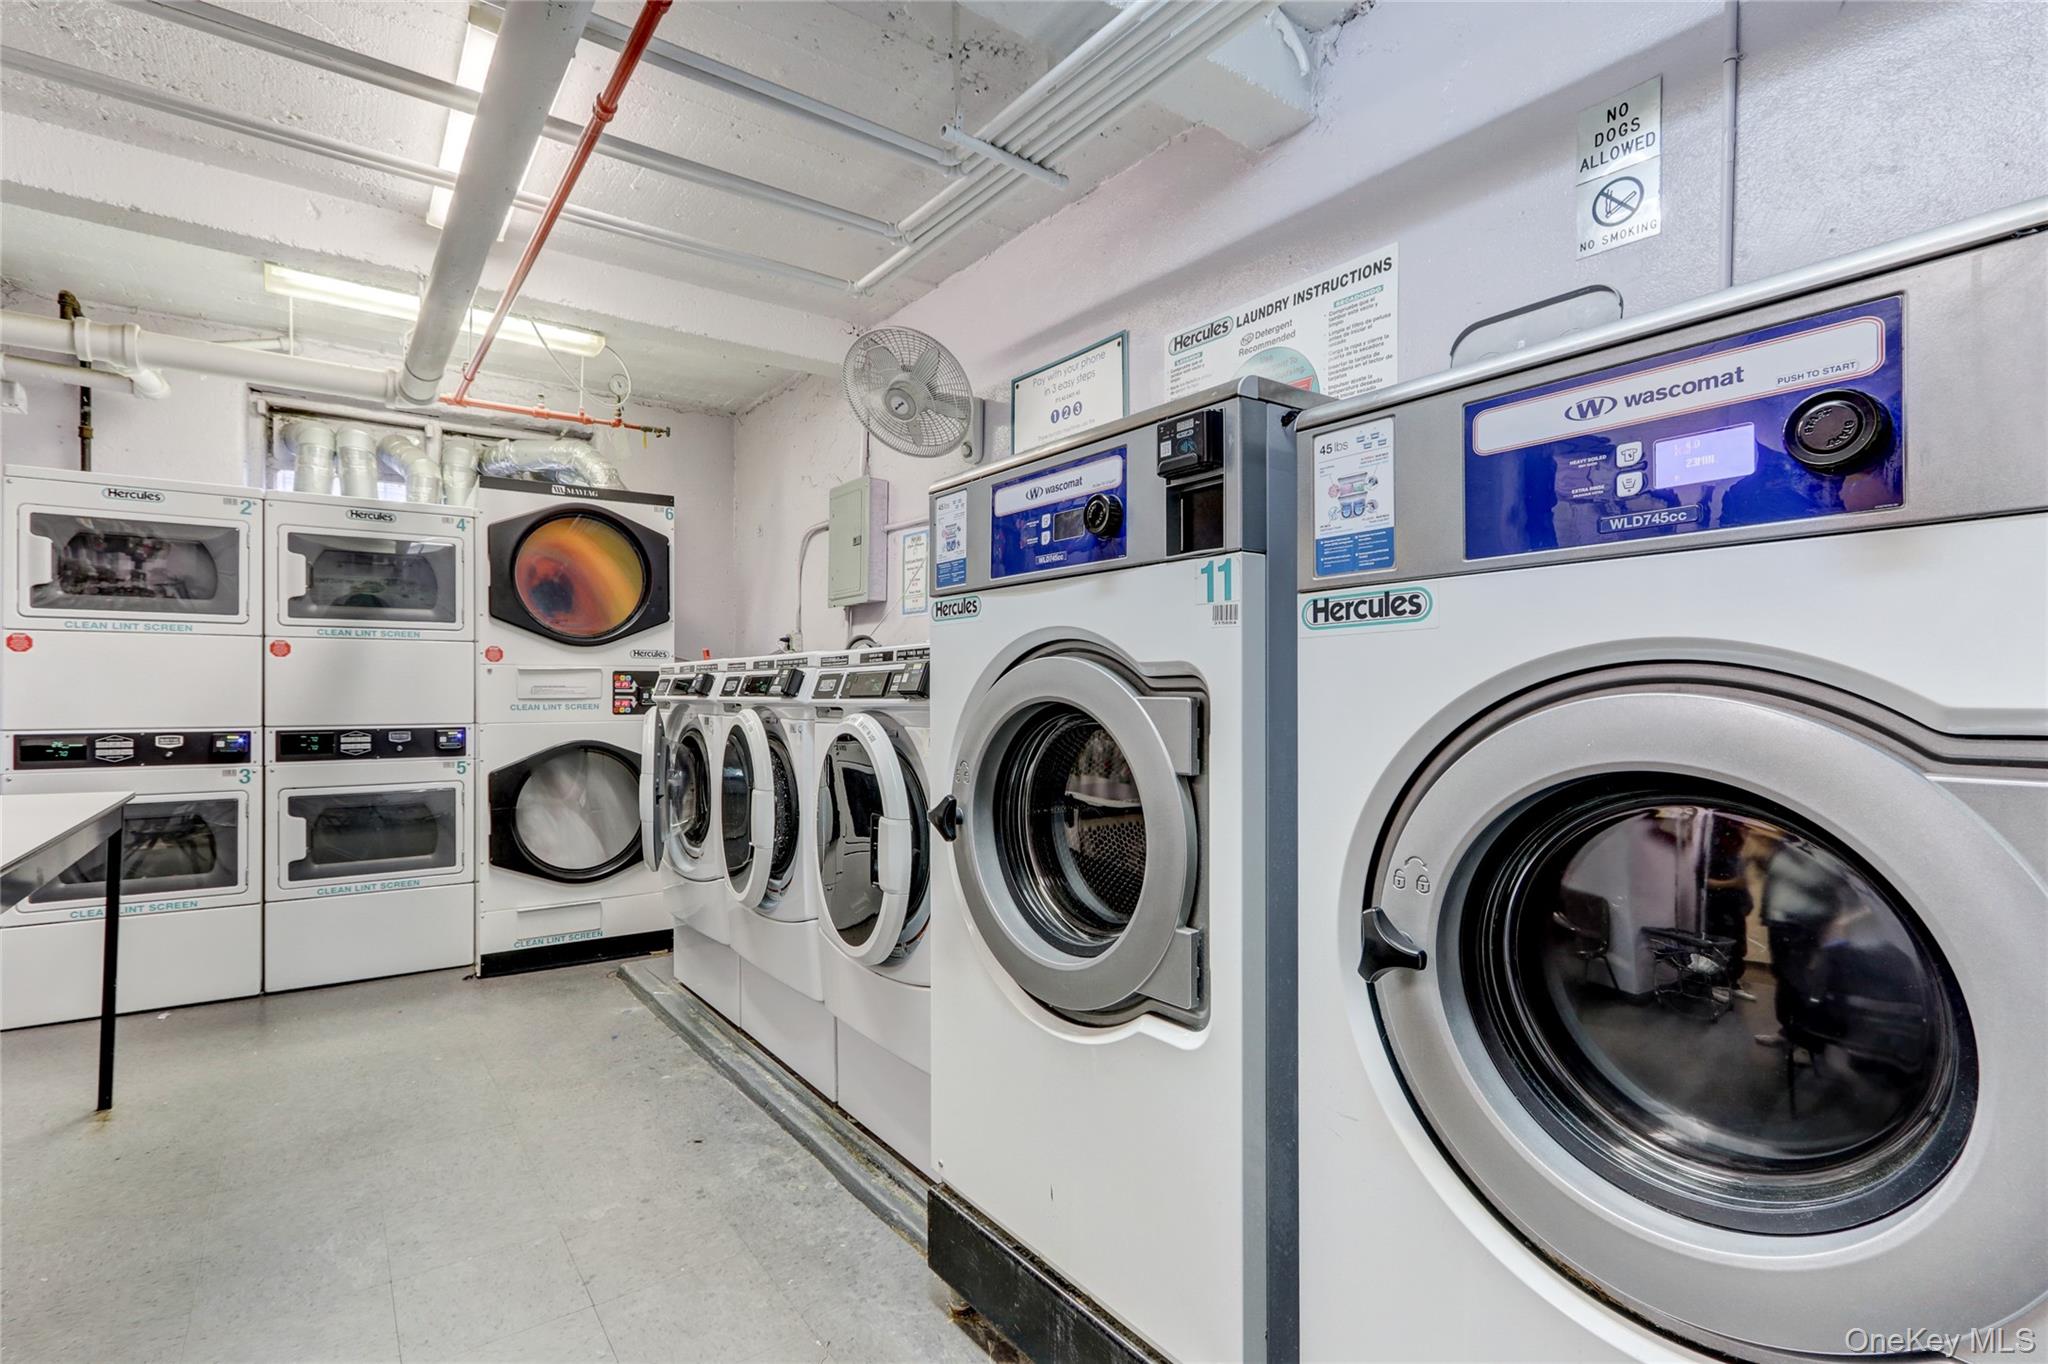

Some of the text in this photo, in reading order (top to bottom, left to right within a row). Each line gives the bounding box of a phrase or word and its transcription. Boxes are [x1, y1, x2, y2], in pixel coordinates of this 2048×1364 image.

[1607, 102, 1628, 123] NO
[1594, 117, 1641, 147] DOGS
[1579, 131, 1656, 173] ALLOWED
[1579, 219, 1657, 252] NO SMOKING
[1173, 257, 1392, 352] Hercules LAUNDRY INSTRUCTIONS
[1255, 320, 1293, 340] Detergent
[1239, 330, 1296, 357] Recommended
[1081, 352, 1105, 370] phone
[1777, 361, 1856, 385] PUSH TO START
[1624, 366, 1745, 408] wascomat
[1320, 441, 1348, 455] 45 lbs
[1569, 458, 1588, 466] HEAVY
[107, 488, 161, 501] Hercules
[1045, 476, 1083, 495] wascomat
[240, 500, 252, 515] 2
[350, 510, 393, 522] Hercules
[664, 507, 674, 520] 6
[456, 518, 466, 532] 4
[1610, 512, 1687, 530] WLD745cc
[1200, 557, 1232, 603] 11
[935, 598, 978, 617] Hercules
[1312, 591, 1422, 623] Hercules
[64, 620, 193, 632] CLEAN LINT SCREEN
[317, 628, 351, 637] CLEAN
[380, 630, 421, 638] SCREEN
[633, 650, 667, 659] Hercules
[510, 704, 540, 712] CLEAN
[565, 703, 600, 711] SCREEN
[239, 768, 251, 784] 3
[456, 760, 466, 774] 5
[317, 880, 420, 895] CLEAN LINT SCREEN
[70, 900, 198, 919] CLEA INT SCREEN
[513, 930, 603, 948] CLEAN LINT SCREEN
